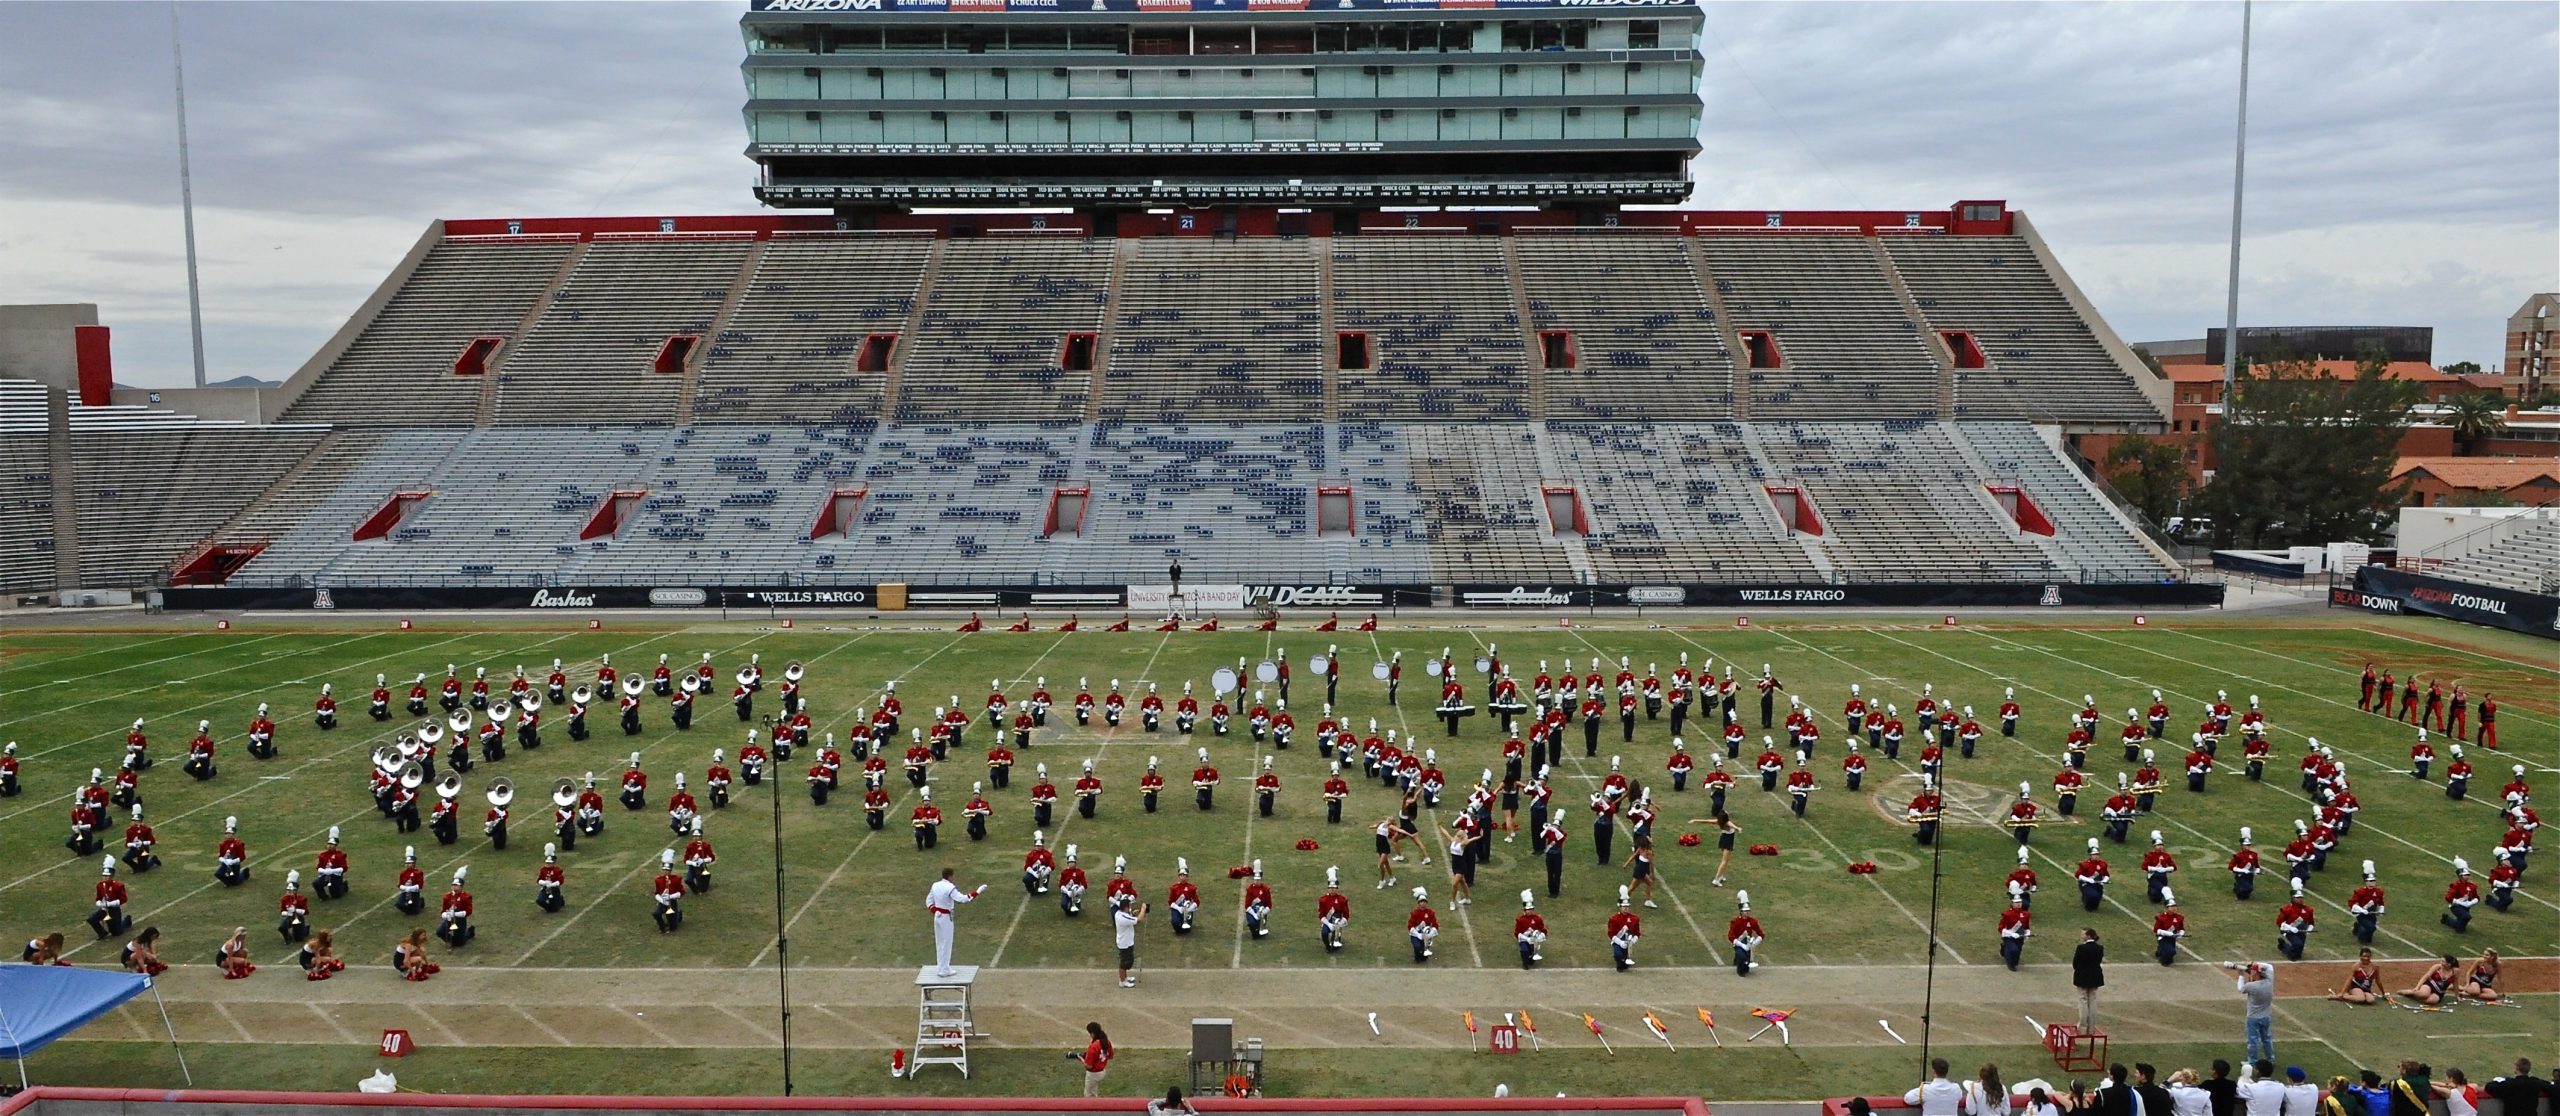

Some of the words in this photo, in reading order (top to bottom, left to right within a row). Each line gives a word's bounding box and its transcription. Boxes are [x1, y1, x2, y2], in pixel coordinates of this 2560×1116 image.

[837, 222, 847, 230] 19
[1033, 220, 1045, 229] 20
[1182, 219, 1193, 228] 21
[1406, 218, 1418, 227] 22
[1605, 218, 1618, 227] 23
[1768, 218, 1780, 227] 24
[1906, 218, 1919, 227] 25
[509, 226, 520, 234] 17
[662, 223, 673, 232] 18
[150, 394, 160, 402] 16
[530, 589, 596, 607] Bashas'
[760, 592, 811, 602] WELLS
[814, 592, 864, 602] FARGO
[1130, 592, 1165, 602] UNIVERSITY
[1207, 592, 1224, 601] BAND
[1227, 592, 1240, 601] DAY
[1740, 590, 1792, 600] WELLS
[1795, 590, 1844, 600] FARGO
[2362, 595, 2398, 611] DOWN
[2450, 594, 2506, 614] FOOTBALL
[382, 1034, 401, 1052] 40
[1495, 1030, 1514, 1048] 40
